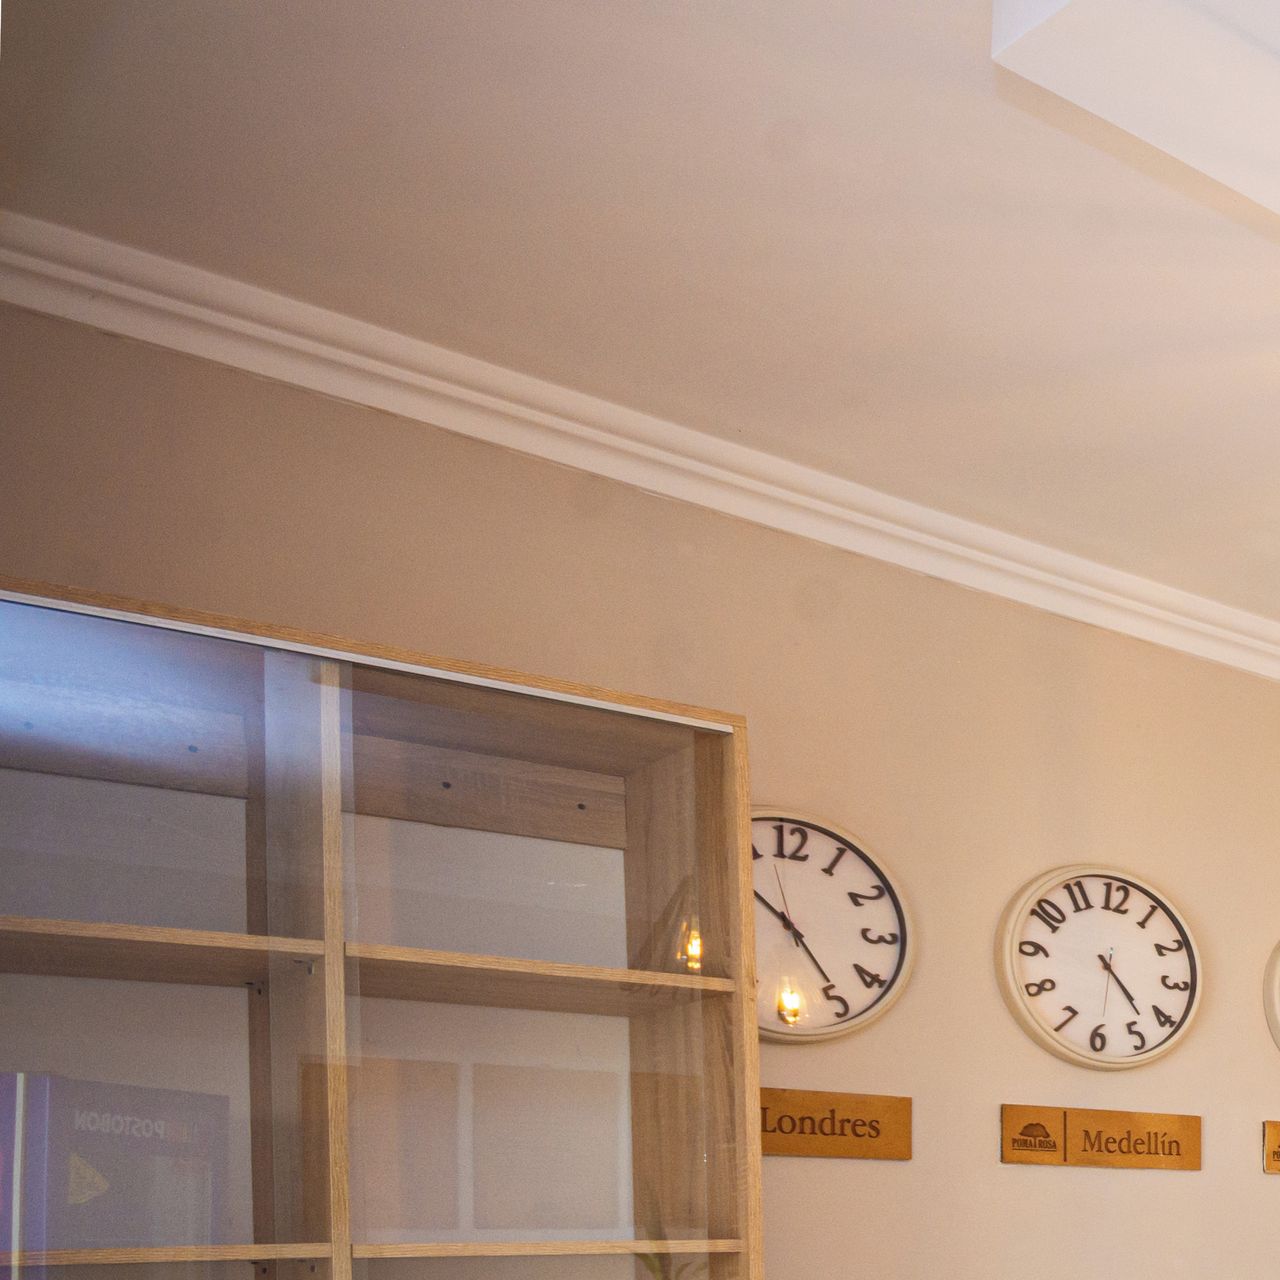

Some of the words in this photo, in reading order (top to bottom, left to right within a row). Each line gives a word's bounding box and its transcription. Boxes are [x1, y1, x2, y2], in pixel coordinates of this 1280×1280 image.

[772, 824, 809, 862] 12
[821, 847, 848, 877] 1
[847, 885, 886, 907] 2
[1063, 880, 1095, 914] 11
[1101, 882, 1130, 915] 12
[1030, 899, 1066, 934] 10
[1136, 904, 1158, 929] 1
[861, 928, 899, 946] 3
[1018, 941, 1050, 958] 9
[1154, 939, 1184, 957] 2
[853, 963, 887, 989] 4
[1025, 978, 1056, 997] 8
[1161, 975, 1190, 992] 3
[822, 984, 850, 1019] 5
[1053, 1005, 1079, 1032] 7
[1152, 1004, 1177, 1028] 4
[1089, 1023, 1107, 1052] 6
[1126, 1021, 1146, 1051] 5
[761, 1106, 880, 1138] Londres
[1081, 1129, 1182, 1156] Medellín
